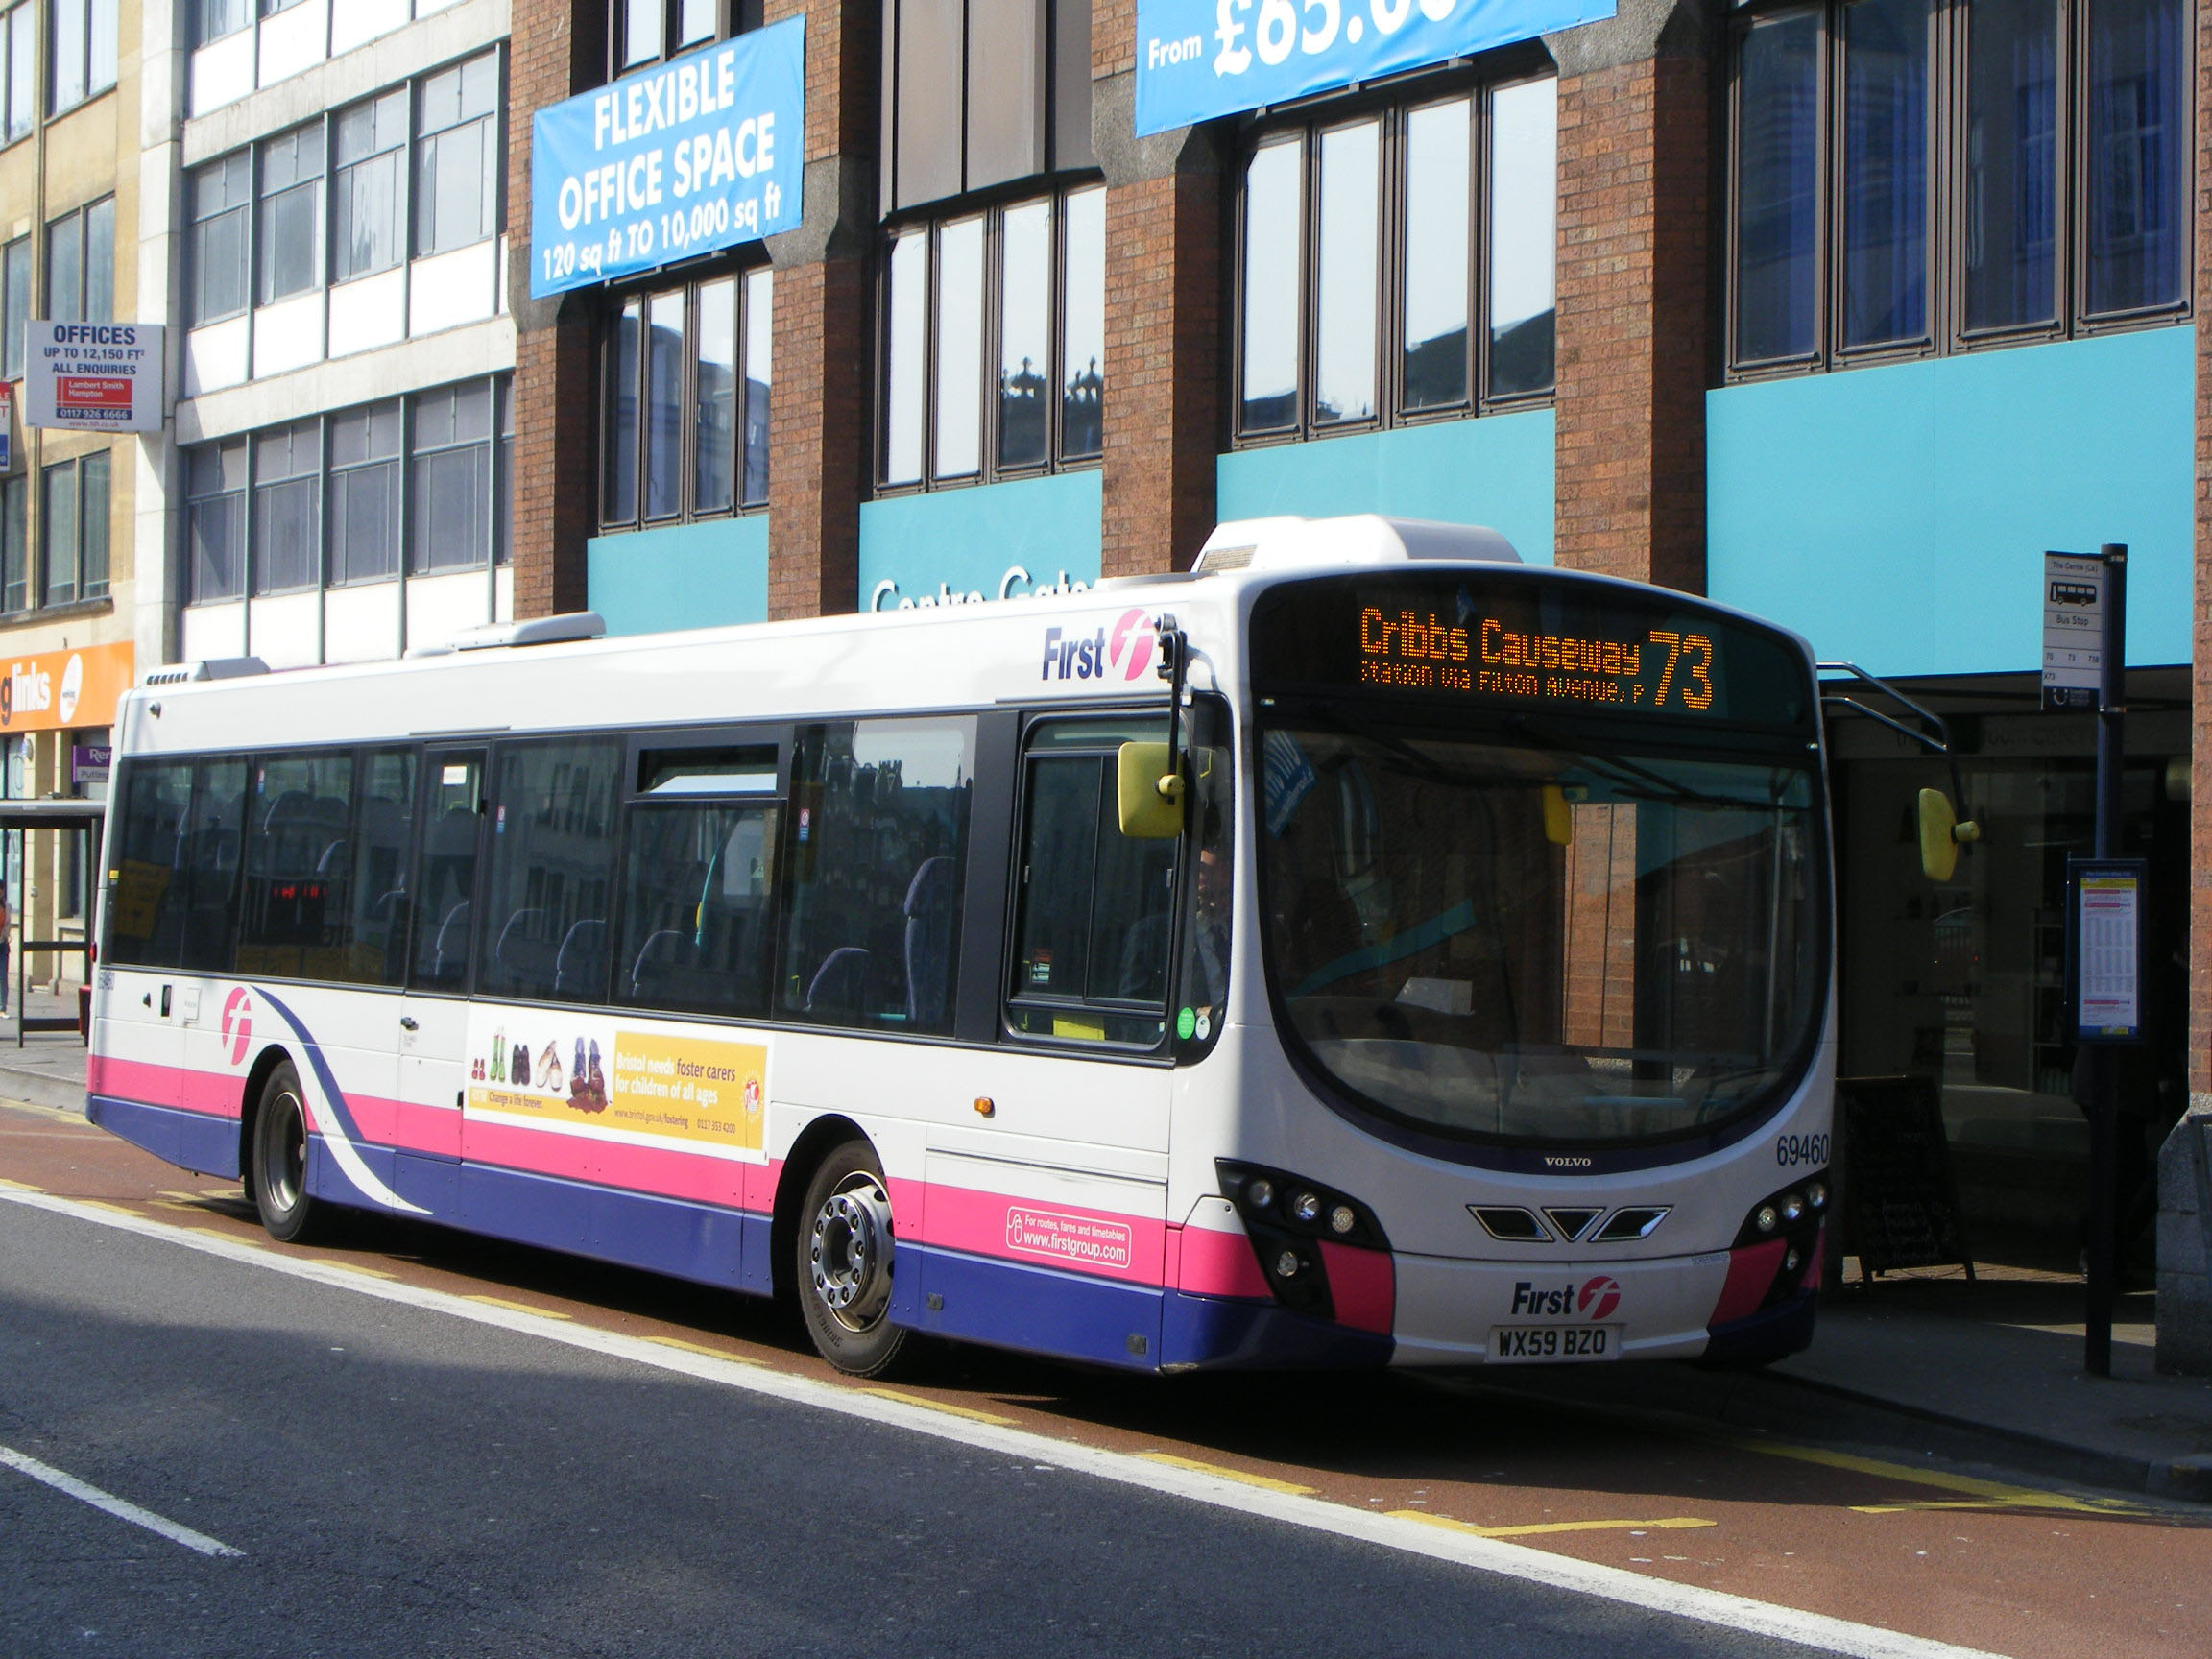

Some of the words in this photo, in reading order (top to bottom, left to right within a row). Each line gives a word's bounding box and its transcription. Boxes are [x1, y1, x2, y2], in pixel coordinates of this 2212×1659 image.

[1148, 33, 1202, 70] From
[1213, 0, 1457, 78] £65.
[594, 50, 735, 151] FLEXIBLE
[558, 149, 662, 231] OFFICE
[673, 111, 775, 199] SPACE
[543, 242, 575, 281] 120
[579, 242, 603, 276] sq
[608, 228, 622, 262] ft
[627, 219, 654, 255] TO
[661, 197, 729, 250] 10,000
[734, 198, 757, 234] sq
[764, 180, 781, 220] ft
[53, 325, 136, 345] OFFICES
[43, 347, 60, 358] UP
[63, 348, 79, 359] TO
[83, 349, 123, 361] 12,150
[52, 363, 73, 373] ALL
[77, 364, 136, 375] ENQUIRIES
[68, 381, 101, 390] Lambert
[102, 381, 124, 390] Smith
[68, 389, 104, 398] Hampton
[60, 409, 81, 418] 0117
[83, 410, 101, 419] 926
[103, 410, 128, 420] 6666
[2056, 614, 2070, 624] Bus
[2073, 615, 2089, 627] Stop
[1042, 627, 1105, 681] First
[1361, 607, 1469, 661] Cribbs
[1481, 618, 1640, 677] Causeway
[1441, 667, 1471, 689] via
[1479, 672, 1538, 696] Filton
[1649, 630, 1713, 709] 73
[615, 1051, 646, 1071] Bristol
[647, 1057, 675, 1076] needs
[677, 1058, 705, 1078] foster
[706, 1065, 736, 1082] carers
[614, 1075, 630, 1093] for
[630, 1077, 668, 1097] children
[670, 1081, 681, 1099] of
[683, 1082, 694, 1101] all
[696, 1089, 718, 1108] ages
[1544, 1157, 1592, 1167] VOLVO
[1776, 1134, 1829, 1166] 69460
[1024, 1214, 1036, 1227] For
[1037, 1217, 1059, 1232] routes,
[1060, 1220, 1076, 1235] fares
[1078, 1224, 1090, 1237] and
[1091, 1225, 1126, 1242] timetables
[1023, 1232, 1126, 1262] www.firstgroup.com
[1511, 1282, 1575, 1315] First
[1499, 1330, 1558, 1358] WX59
